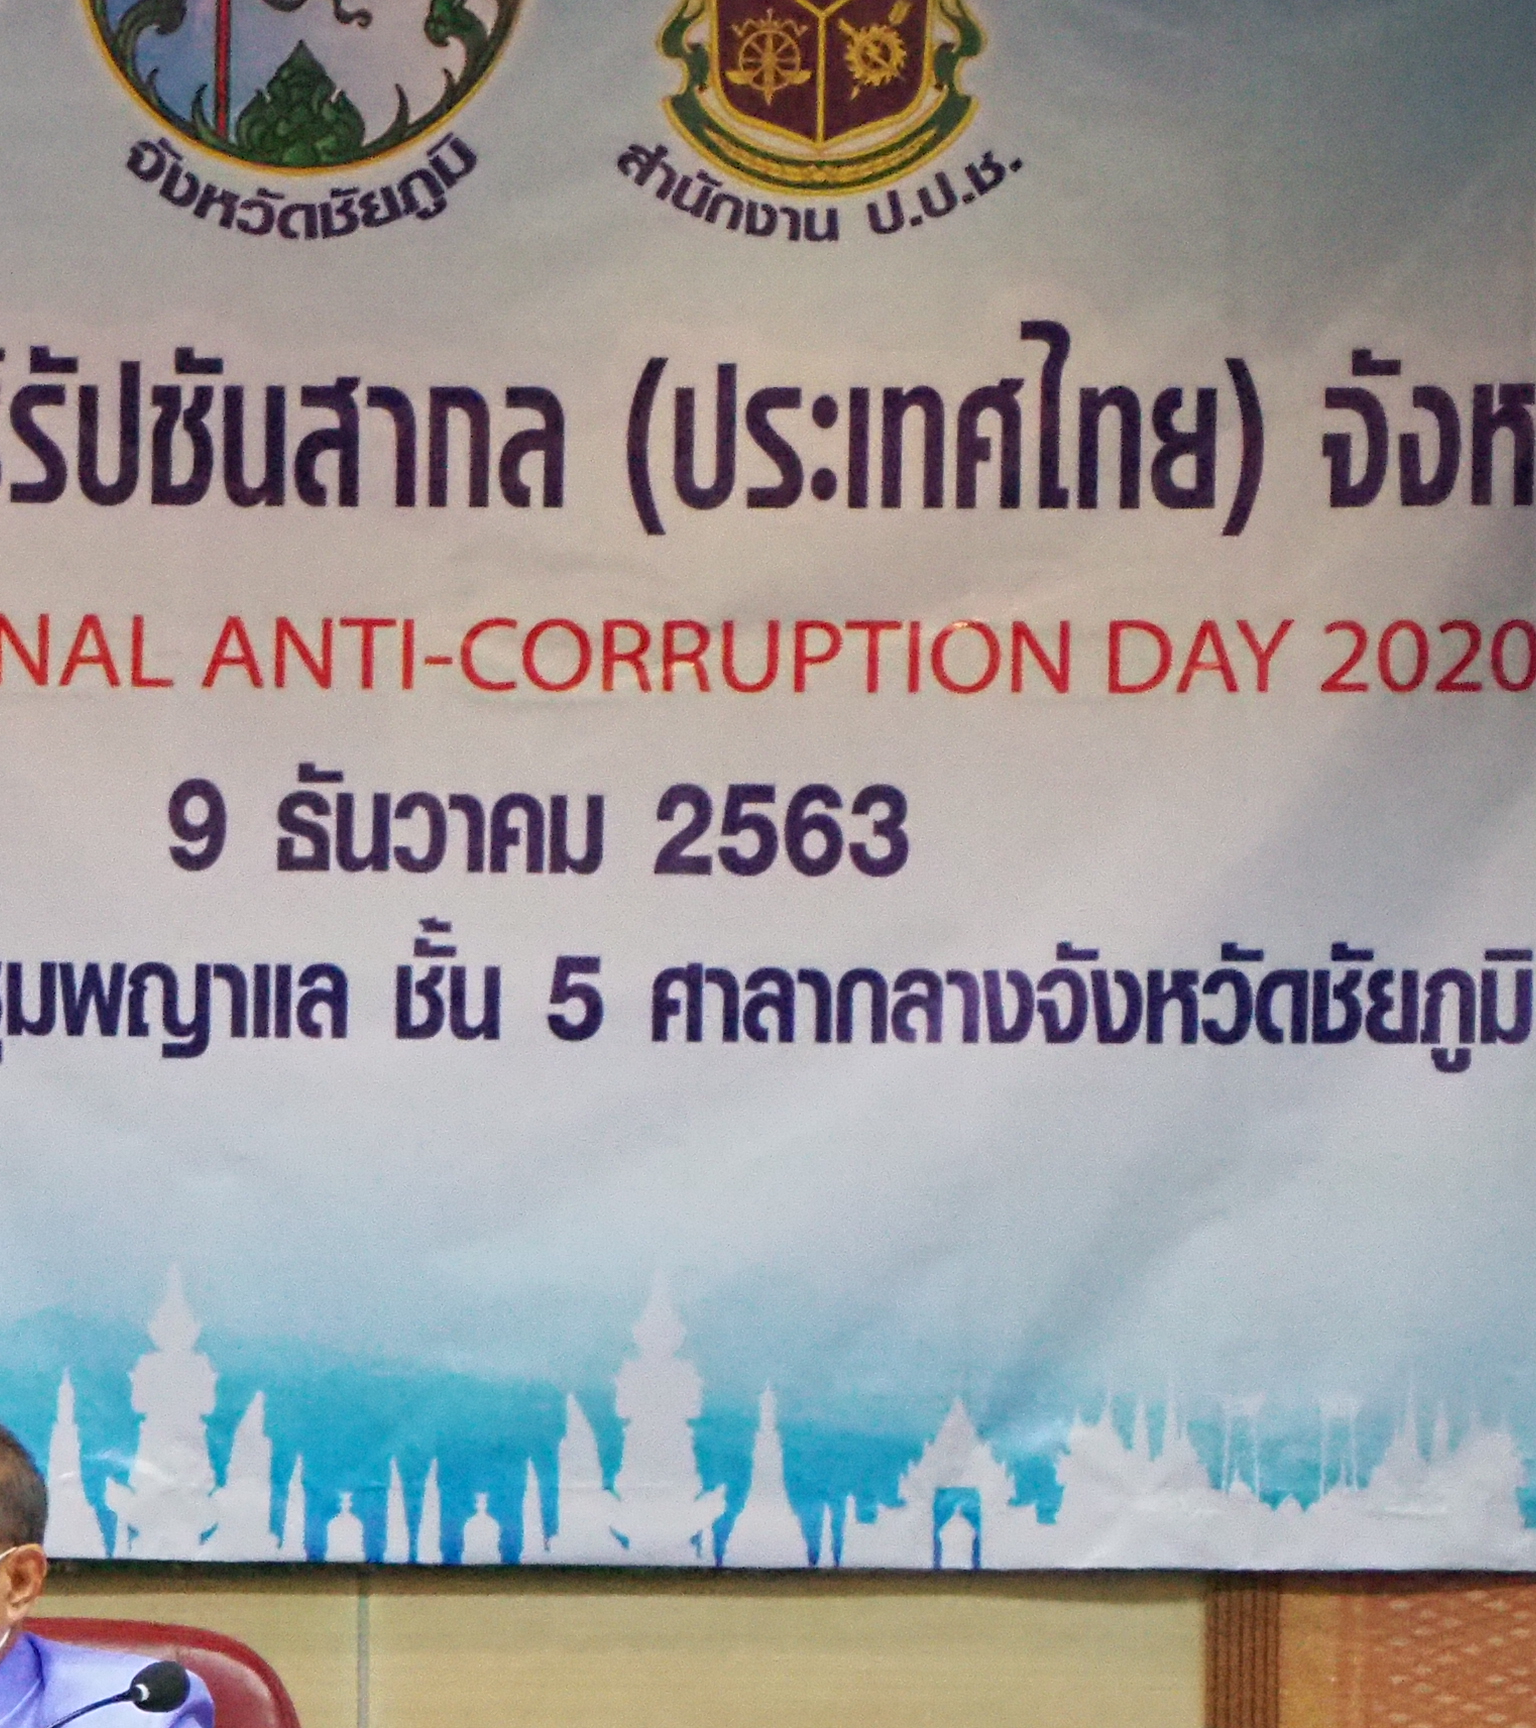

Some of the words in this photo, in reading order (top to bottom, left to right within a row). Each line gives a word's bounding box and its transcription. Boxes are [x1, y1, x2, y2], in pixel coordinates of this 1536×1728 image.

[126, 132, 478, 240] จังหวัดชัยภูมิ
[616, 142, 840, 243] สำนักงาน
[865, 149, 1024, 236] ป.ป.ช.
[626, 320, 1265, 537] (ประเทศไทย)
[1322, 348, 1536, 508] จังห
[202, 615, 1071, 695] ANTI-CORRUPTION
[1108, 619, 1294, 695] DAY
[1321, 619, 1536, 693] 2020
[168, 778, 227, 872] 9
[276, 762, 605, 875] ธันวาคม
[653, 783, 909, 878] 2563
[394, 917, 501, 1041] ชั้น
[546, 955, 604, 1042] 5
[651, 941, 1534, 1074] ศาลากลางจังหวัดชัยภูมิ
